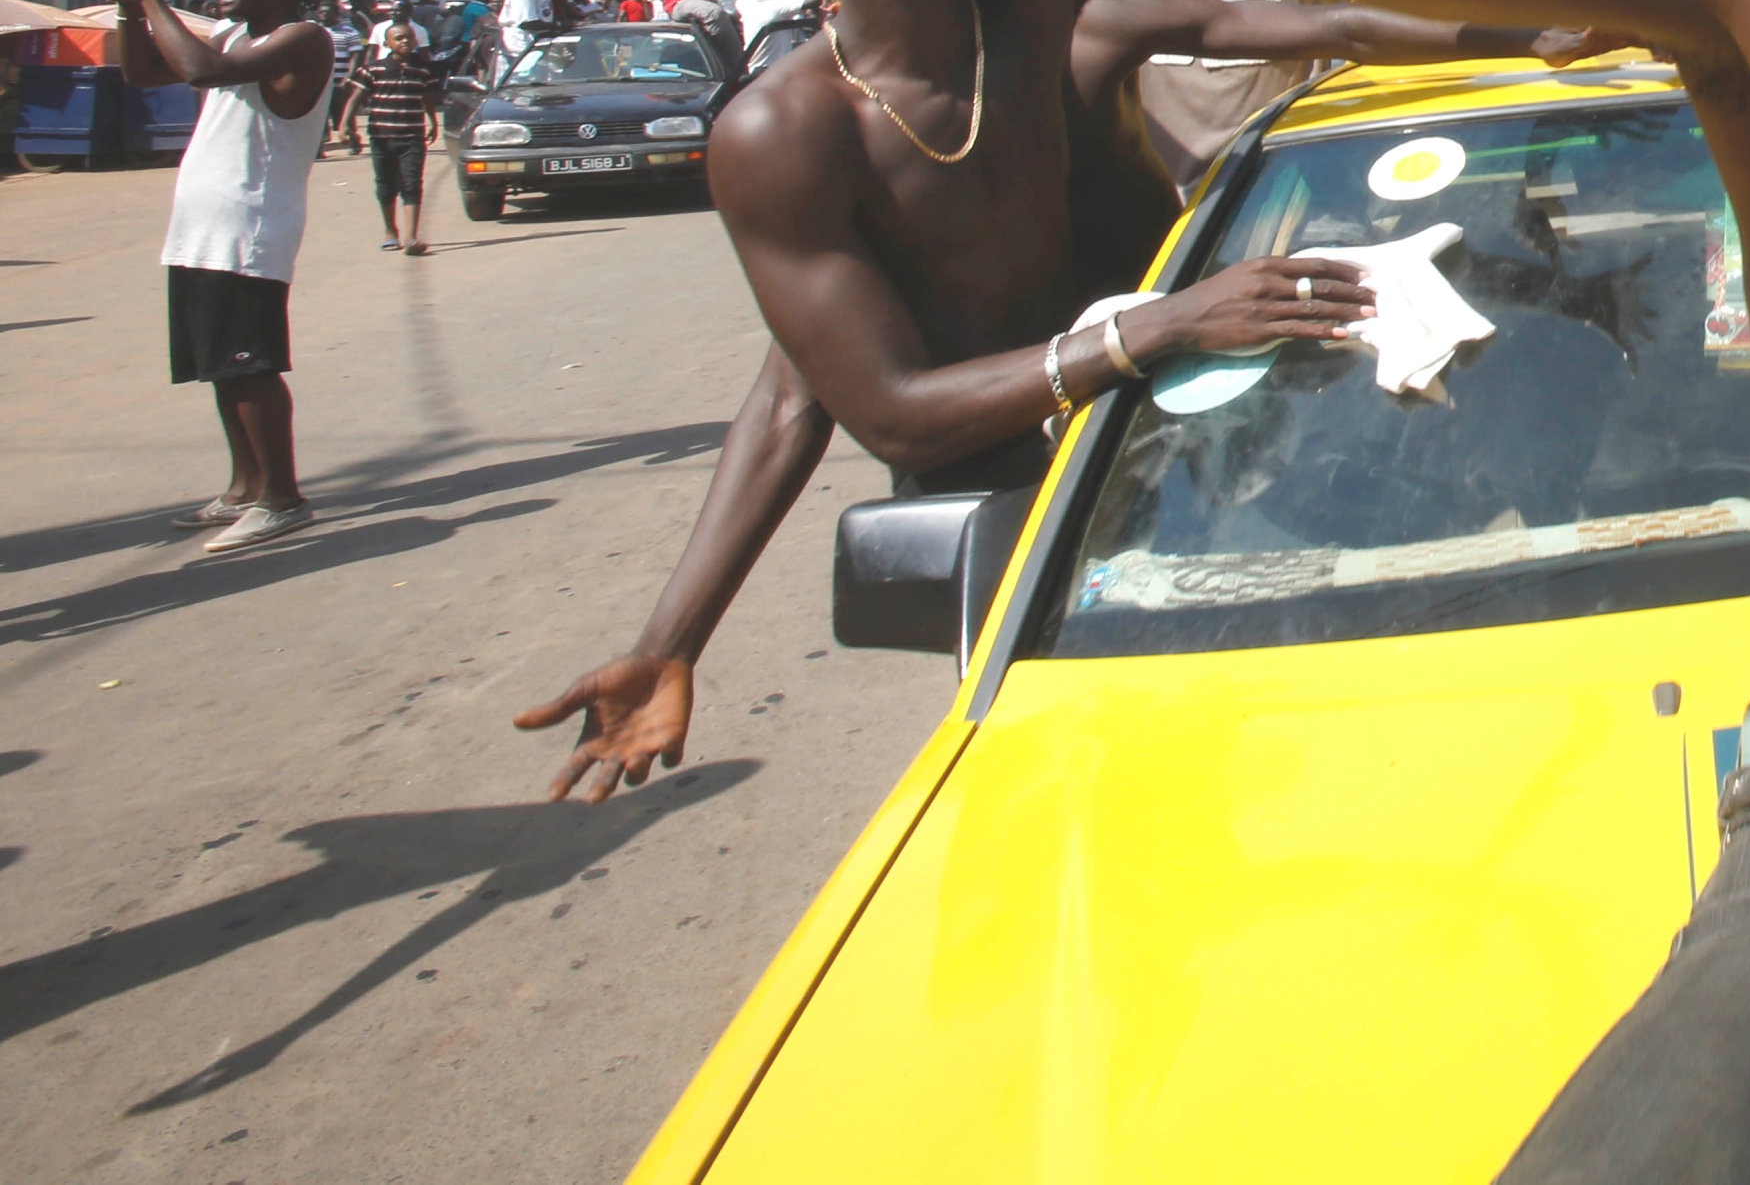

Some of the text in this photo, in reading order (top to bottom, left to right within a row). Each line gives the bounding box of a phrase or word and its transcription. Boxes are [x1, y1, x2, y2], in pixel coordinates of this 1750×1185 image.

[550, 156, 625, 171] BJL 5168 J
